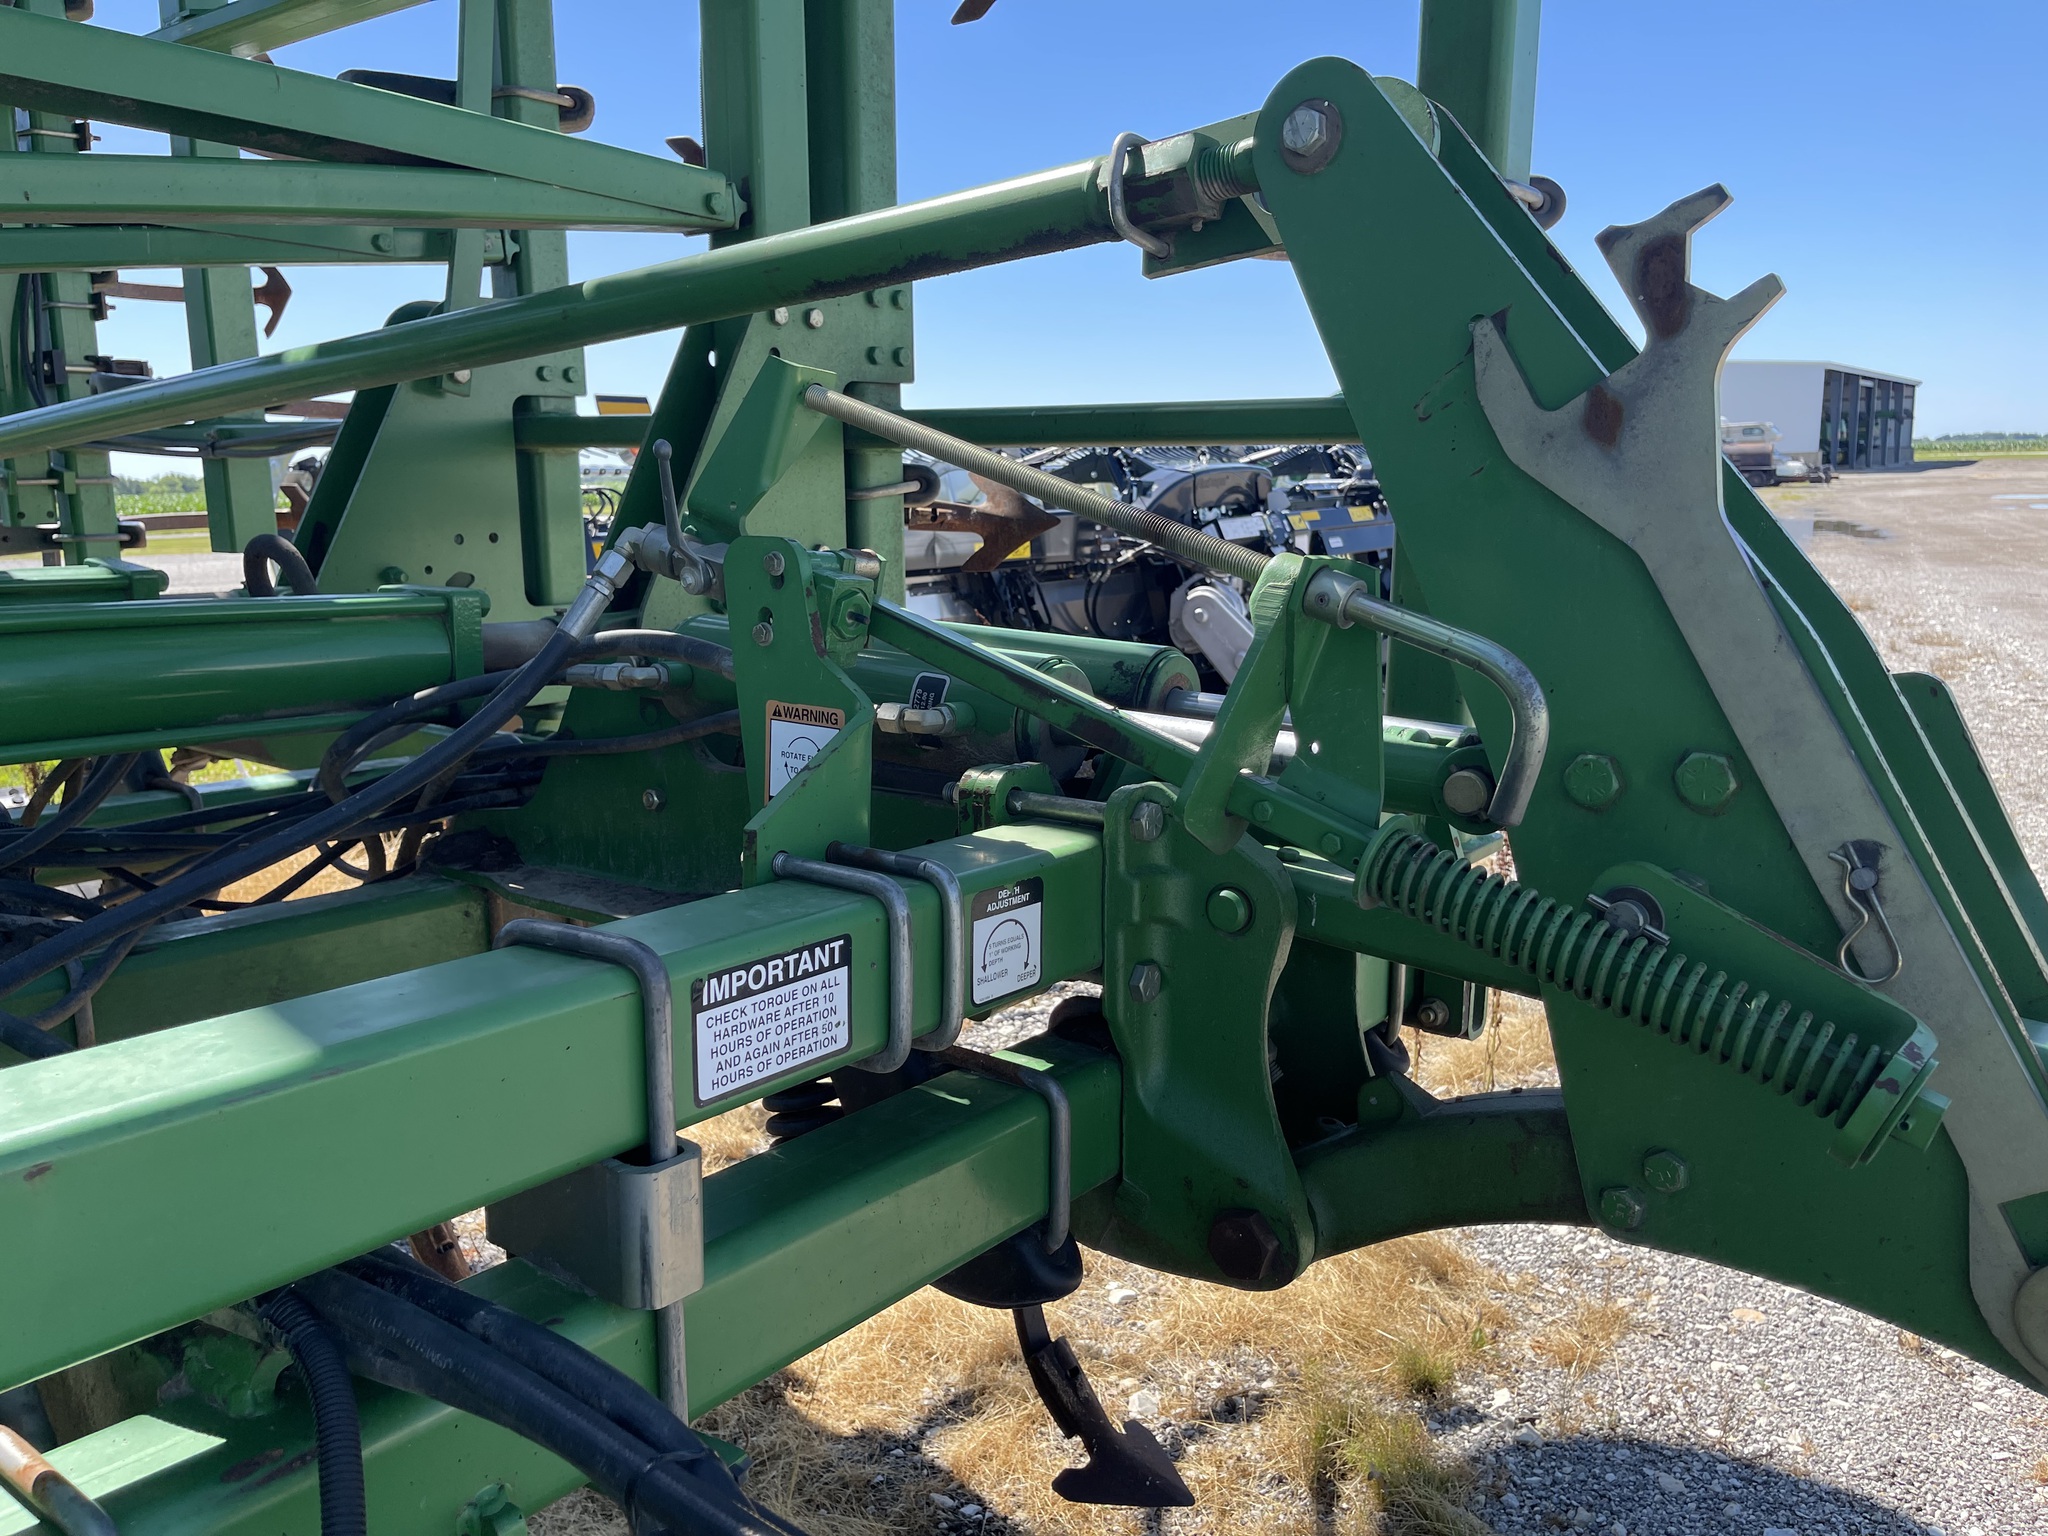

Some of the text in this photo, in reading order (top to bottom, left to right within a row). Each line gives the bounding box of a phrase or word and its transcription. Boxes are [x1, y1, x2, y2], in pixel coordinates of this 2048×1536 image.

[783, 705, 838, 726] WARNING
[780, 750, 806, 761] ROTATE
[790, 765, 799, 774] TO
[986, 892, 1030, 913] ADJUSTMENT
[992, 938, 1007, 949] TURNS
[1007, 933, 1025, 944] EQUALS
[994, 948, 1001, 957] OF
[1001, 942, 1022, 954] WORKING
[988, 956, 1004, 967] DEPTH
[702, 939, 844, 1007] IMPORTANT
[976, 968, 1037, 986] SHALLOWER DEEPER
[706, 976, 840, 1029] CHECK TORQUE ON ALL
[713, 992, 834, 1043] HARDWARE AFTER 10
[710, 1005, 837, 1059] HOURS OF OPERATION
[715, 1021, 834, 1074] AND AGAIN AFTER 50
[711, 1034, 838, 1091] HOURS OF OPERATION
